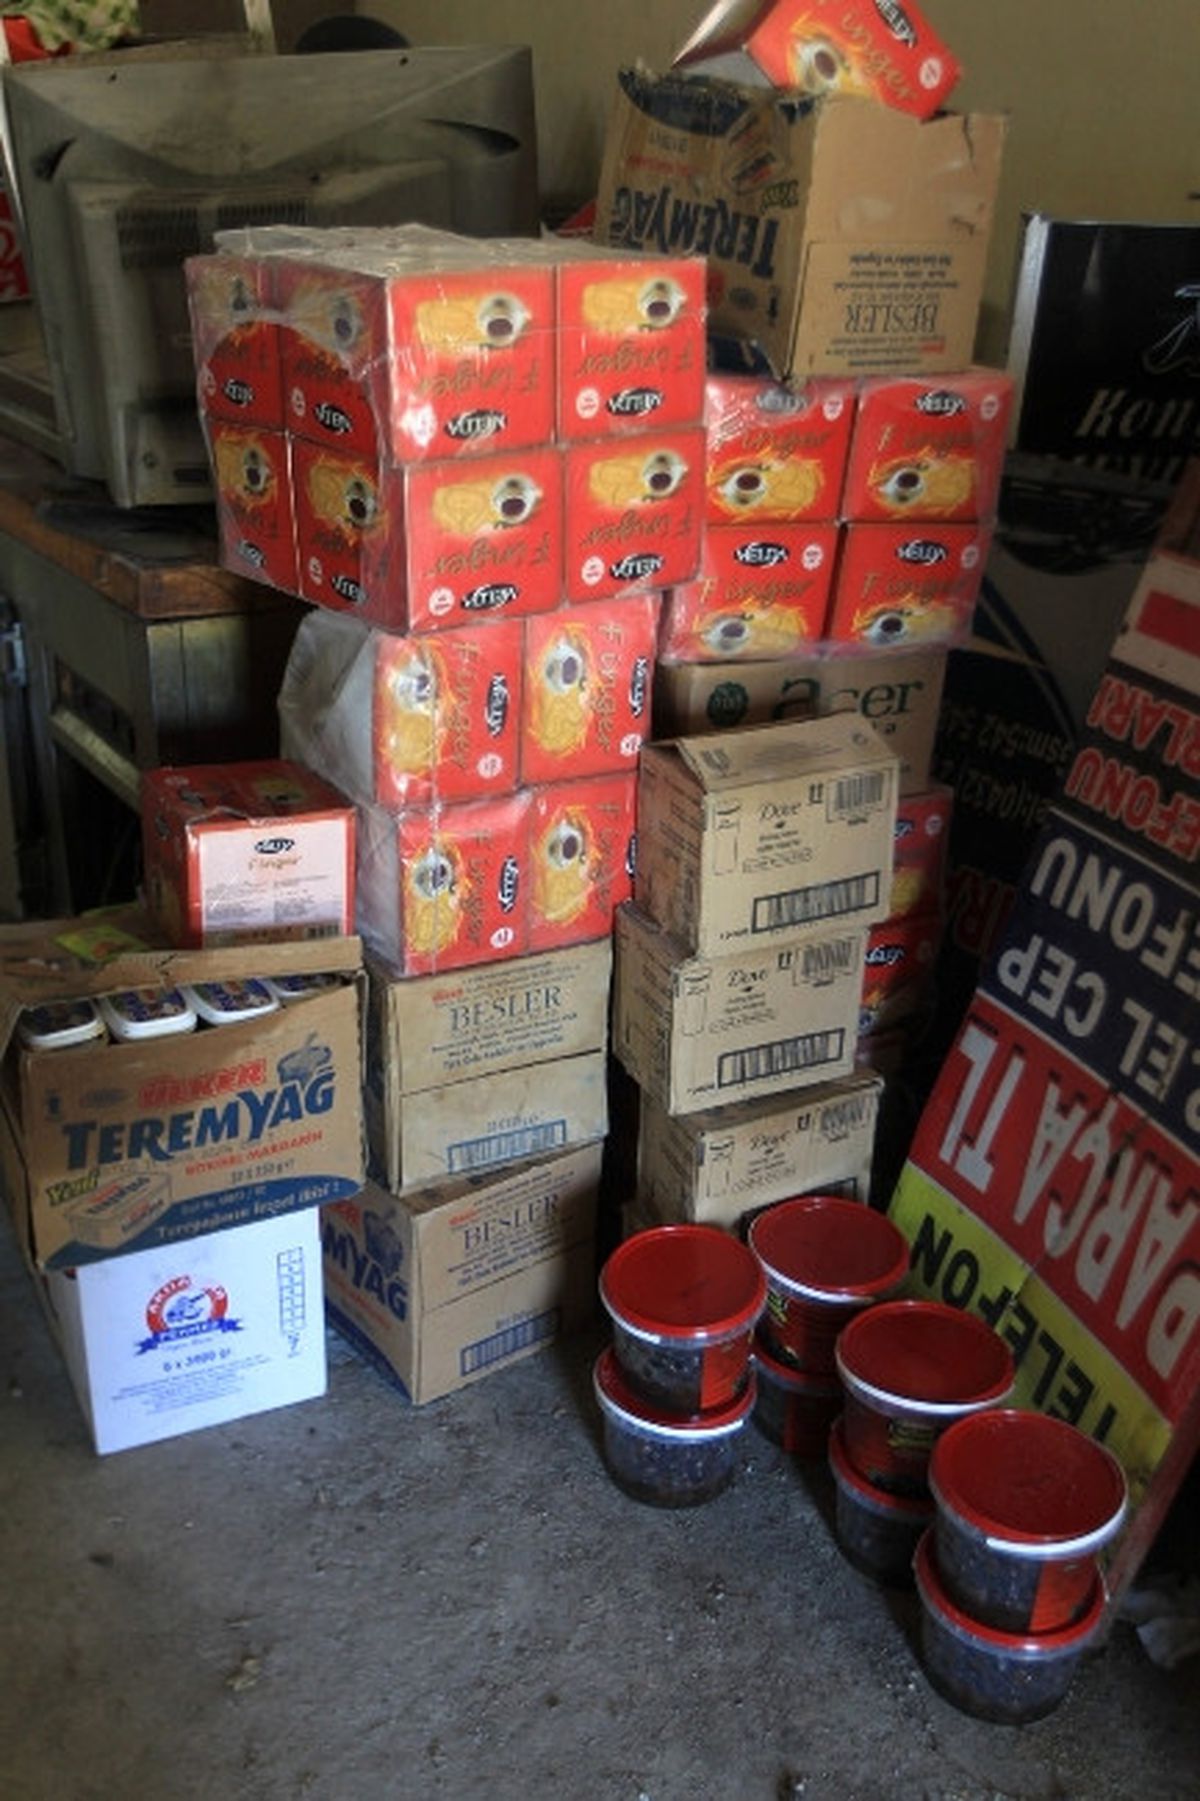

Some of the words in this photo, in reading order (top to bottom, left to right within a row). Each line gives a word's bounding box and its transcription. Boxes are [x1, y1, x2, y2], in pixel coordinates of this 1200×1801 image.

[843, 303, 938, 334] BESLER
[451, 985, 562, 1031] BESLER
[997, 934, 1107, 1038] CEP
[62, 1064, 336, 1171] TEREMYAĞ
[463, 1194, 560, 1250] BESLER
